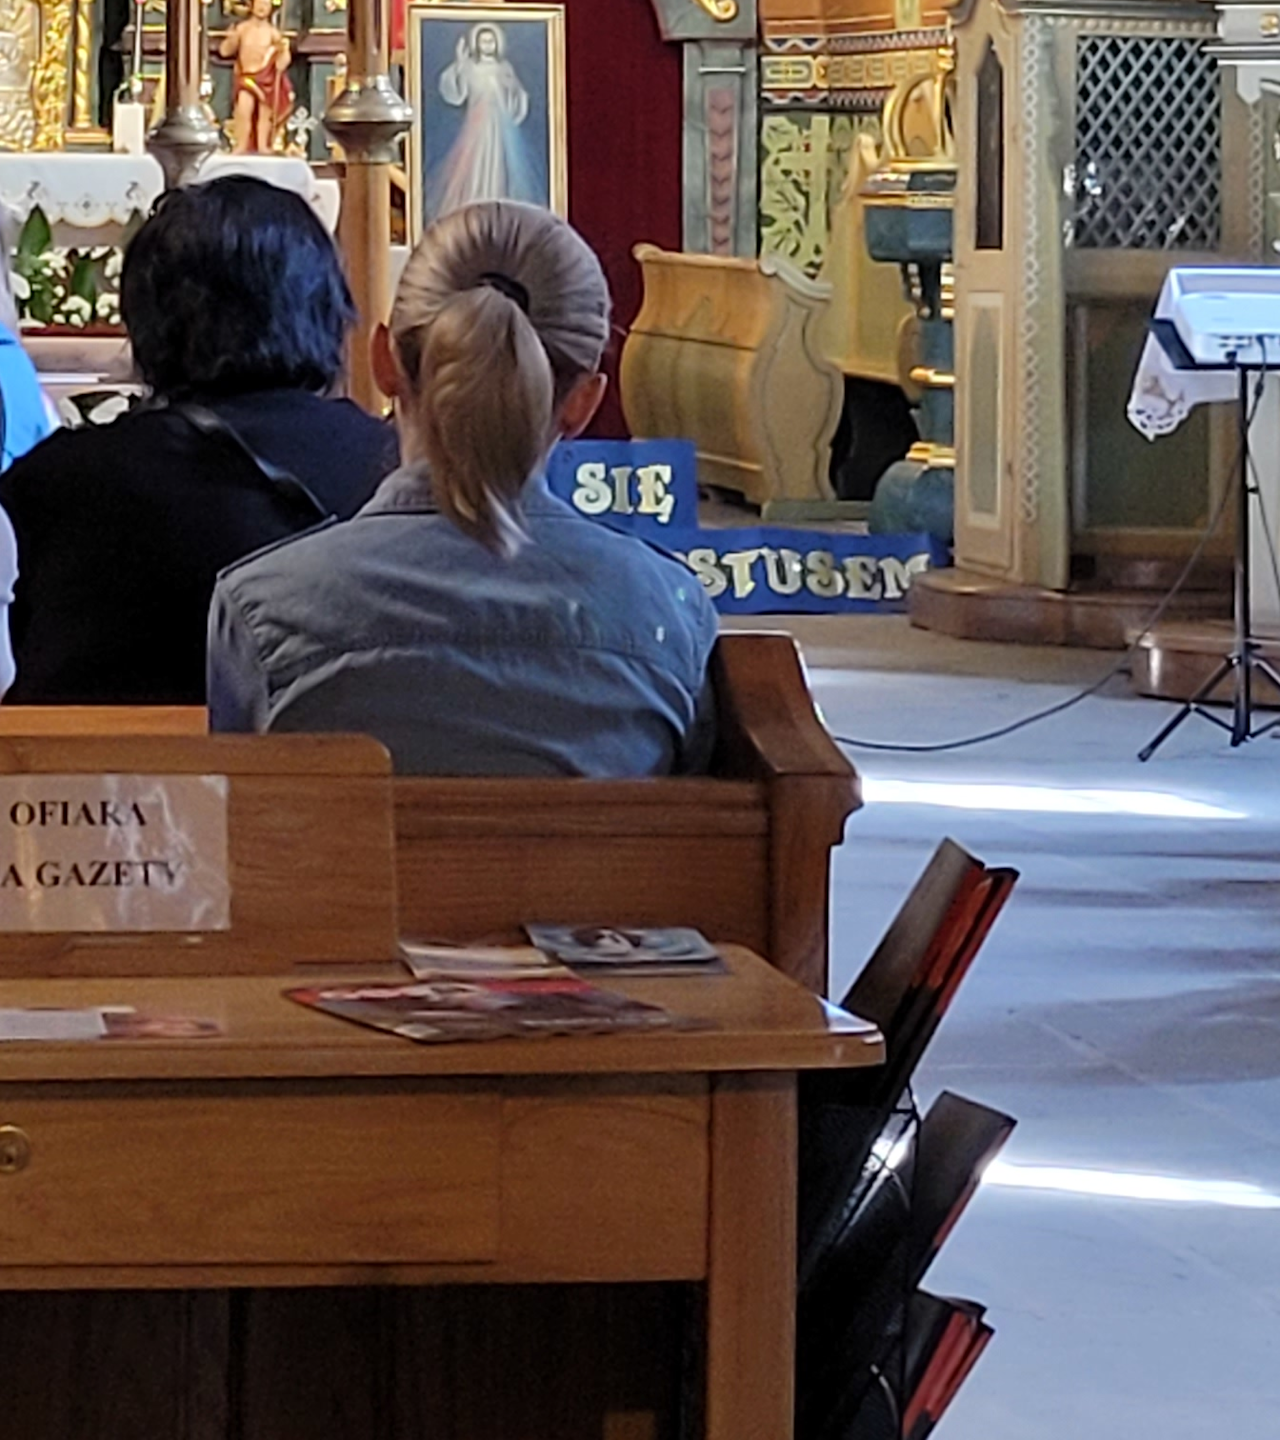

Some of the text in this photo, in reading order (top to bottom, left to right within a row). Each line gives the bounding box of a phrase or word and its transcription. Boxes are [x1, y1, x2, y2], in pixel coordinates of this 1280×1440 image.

[572, 462, 675, 524] SIĘ
[675, 547, 930, 600] STUSEM
[9, 800, 148, 827] OFIARA
[35, 859, 185, 889] GAZETY
